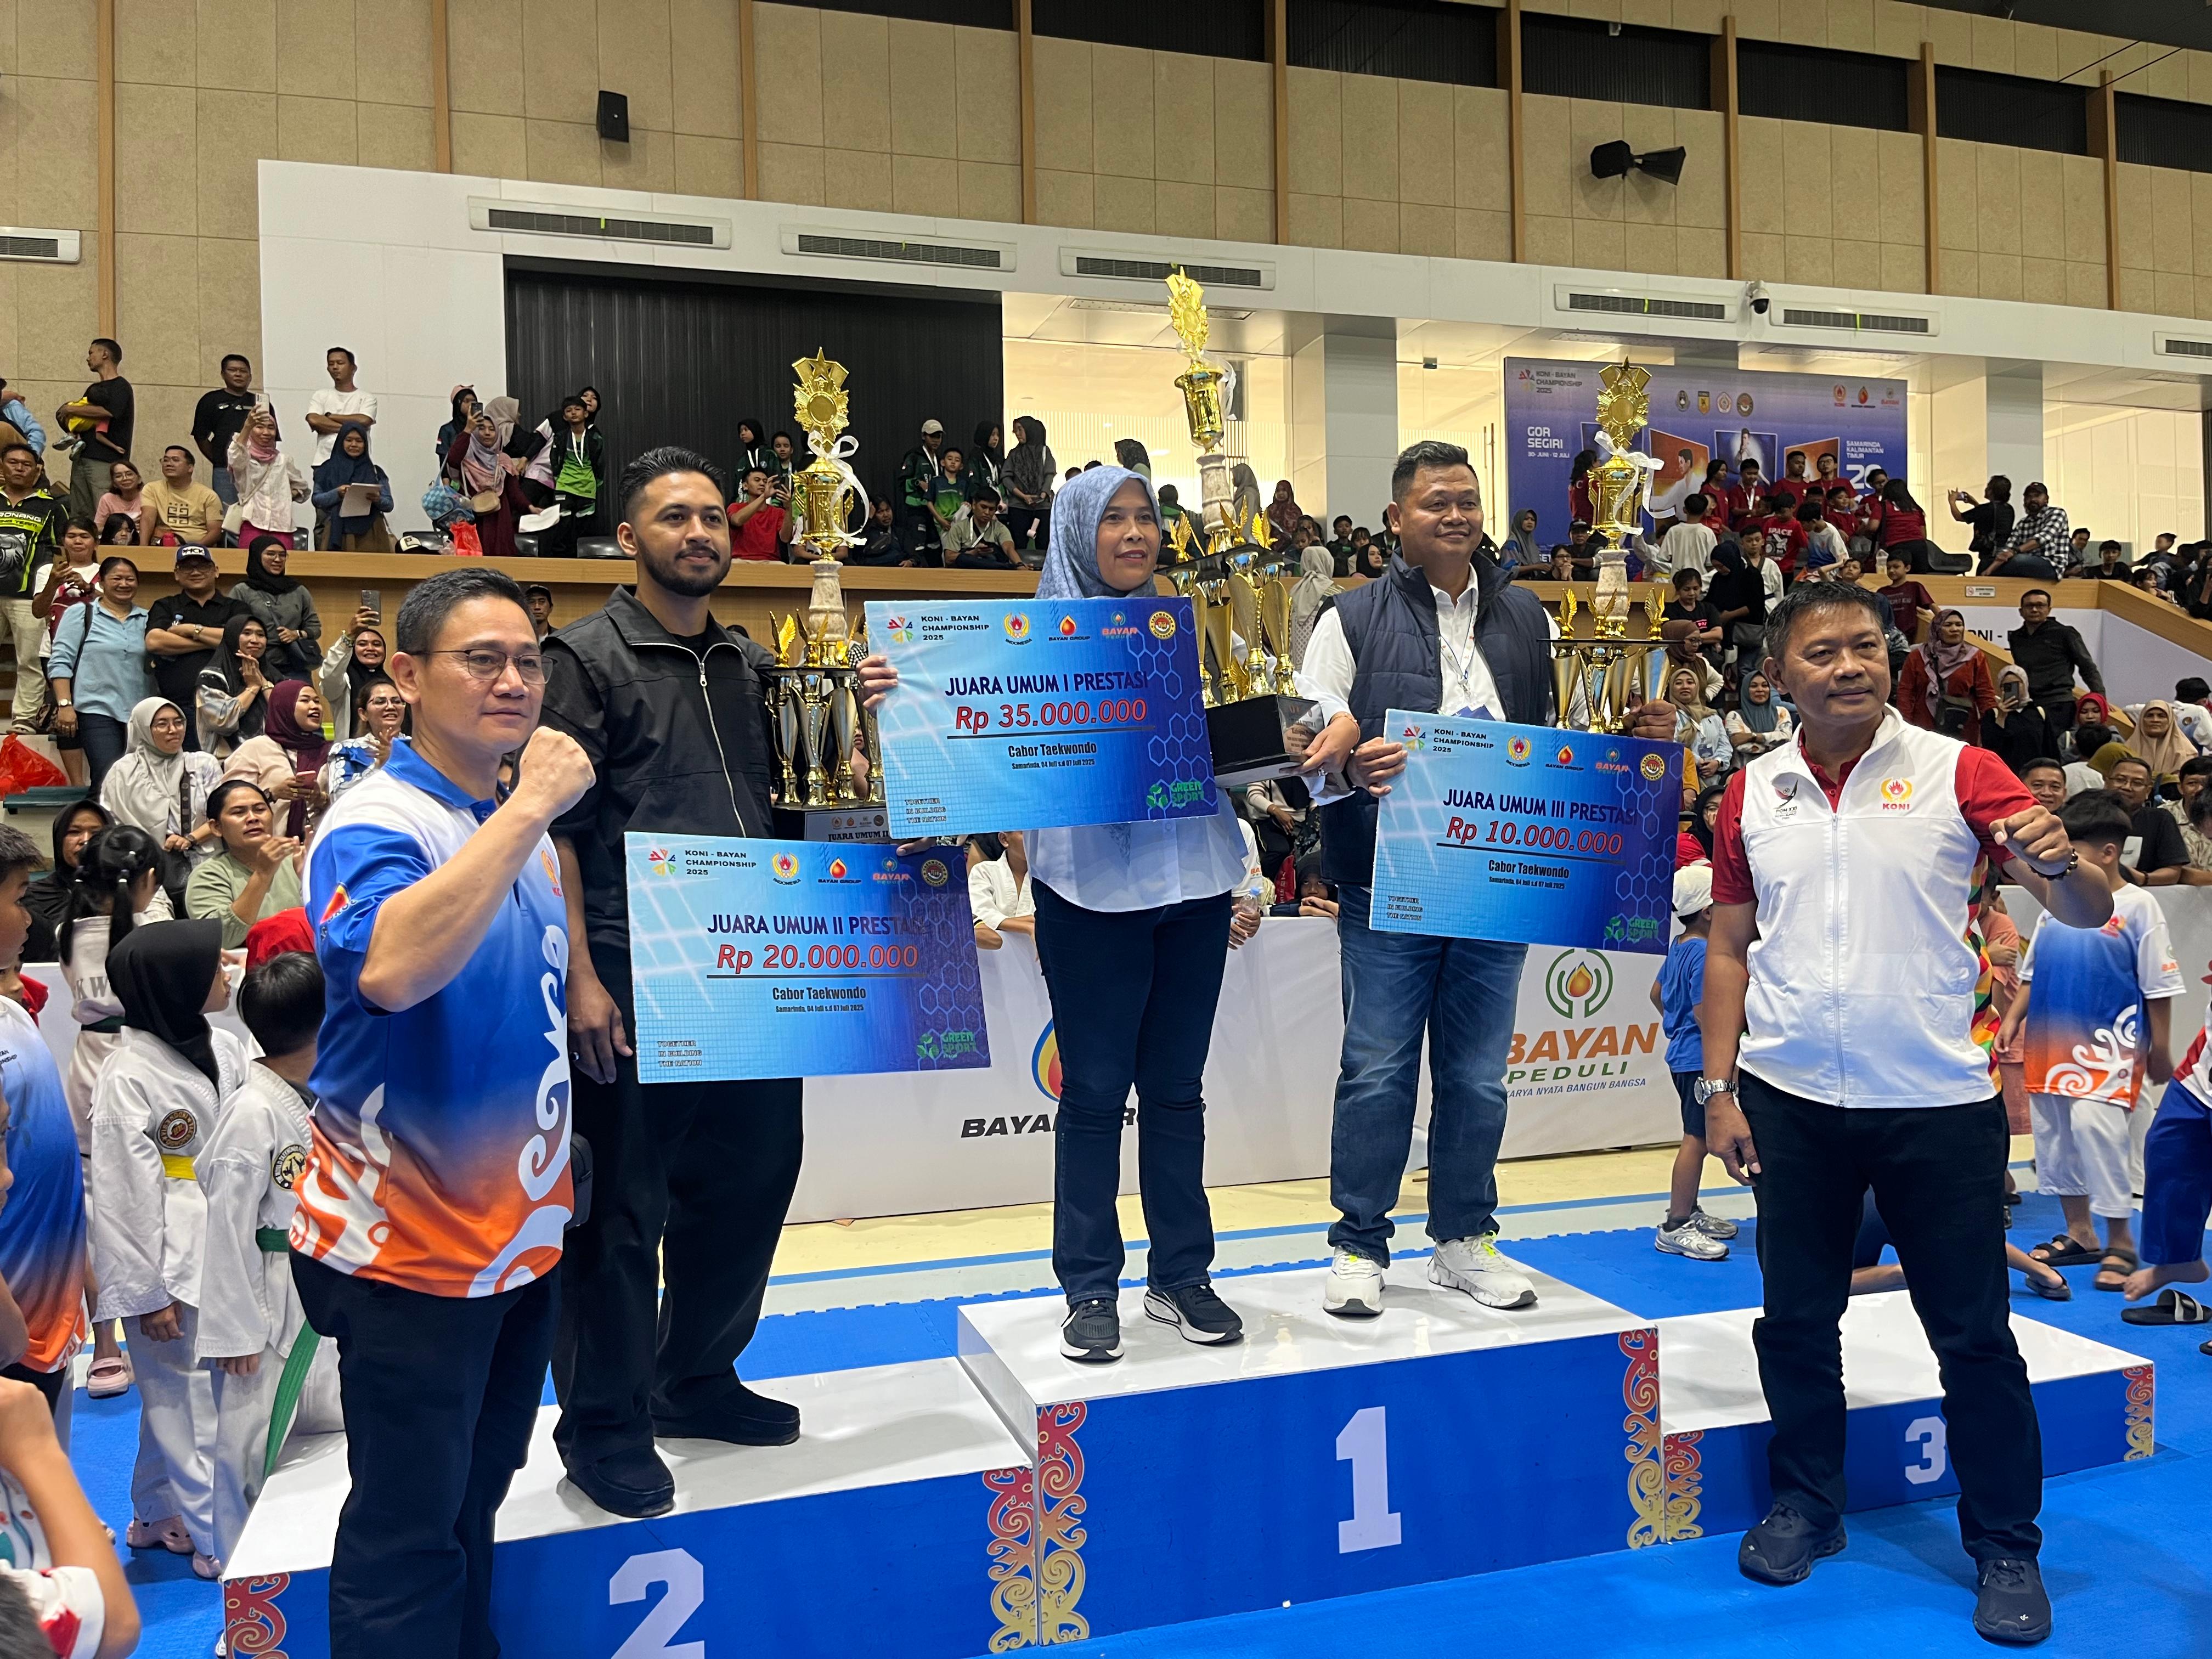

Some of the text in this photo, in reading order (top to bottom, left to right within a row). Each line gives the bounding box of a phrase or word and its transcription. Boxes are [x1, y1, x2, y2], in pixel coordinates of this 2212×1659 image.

[1527, 426, 1550, 437] GOR
[1527, 438, 1563, 449] SEGIRI
[1102, 627, 1137, 635] BAYAN
[945, 670, 1149, 696] JUARA UMUM I PRESTASI
[956, 698, 1147, 734] Rp 35.000.000
[1461, 731, 1487, 740] BAYAN
[1008, 742, 1097, 758] Cabor Taekwondo
[1434, 737, 1494, 749] CHAMPIONSHIP
[1505, 759, 1531, 768] INDONESIA
[1595, 762, 1629, 772] BAYAN
[1170, 781, 1201, 792] GREEN
[1171, 791, 1205, 802] SPORT
[1443, 789, 1638, 826] JUARA UMUM III PRESTASI
[828, 833, 853, 842] JUARA
[1446, 816, 1623, 855] Rp 10.000.000
[686, 859, 757, 868] CHAMPIONSHIP
[1488, 860, 1570, 878] Cabor Taekwondo
[707, 915, 929, 935] JUARA UMUM II PRESTA
[1629, 917, 1657, 929] GREEN
[1628, 928, 1658, 939] SPORT
[717, 944, 918, 974] Rp 20.000.000
[772, 986, 866, 1000] Cabor Taekwondo
[942, 1031, 974, 1042] GREEN
[943, 1042, 977, 1053] SPORT
[1506, 1023, 1659, 1065] BAYAN
[1507, 1062, 1628, 1085] PEDULI
[1536, 1085, 1563, 1096] NYATA
[1567, 1081, 1607, 1093] BANGUN
[1609, 1078, 1646, 1090] BANGSA
[961, 1113, 1058, 1138] BAYA
[1905, 1415, 1946, 1485] 3
[1336, 1406, 1402, 1554] 1
[610, 1548, 705, 1659] 2
